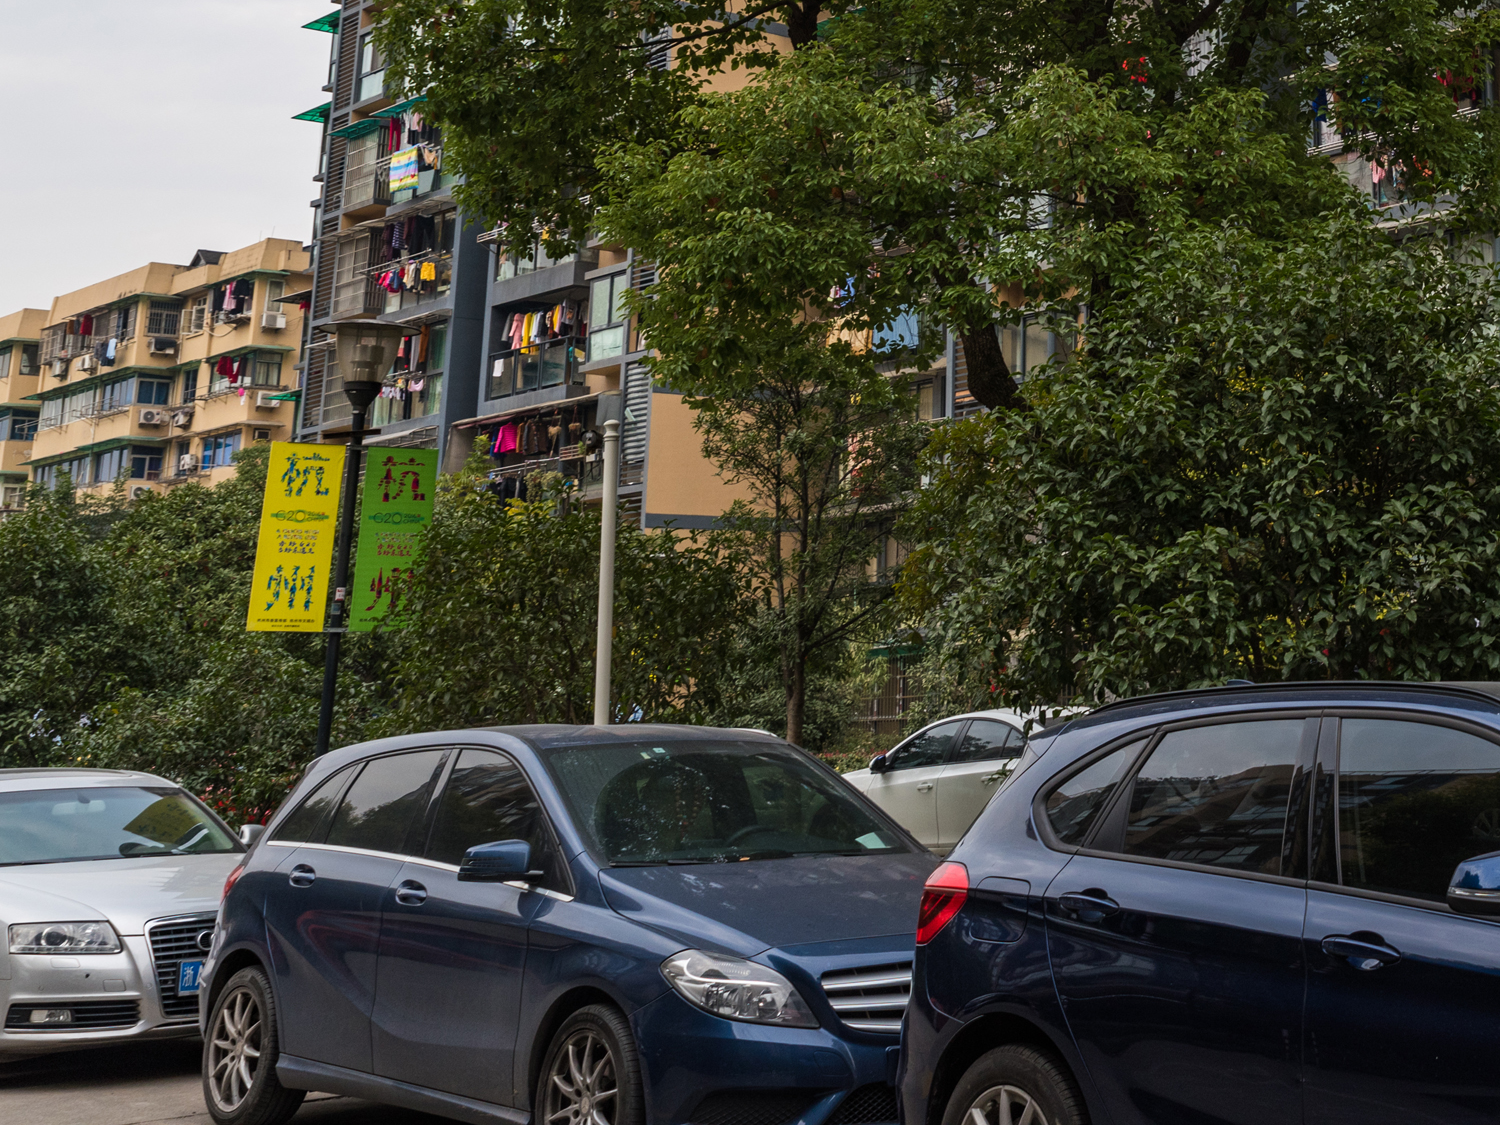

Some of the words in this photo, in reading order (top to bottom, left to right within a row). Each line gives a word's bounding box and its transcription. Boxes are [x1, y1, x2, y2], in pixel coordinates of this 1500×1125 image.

[377, 455, 426, 503] 杭
[276, 509, 306, 523] G20
[373, 512, 402, 524] G20
